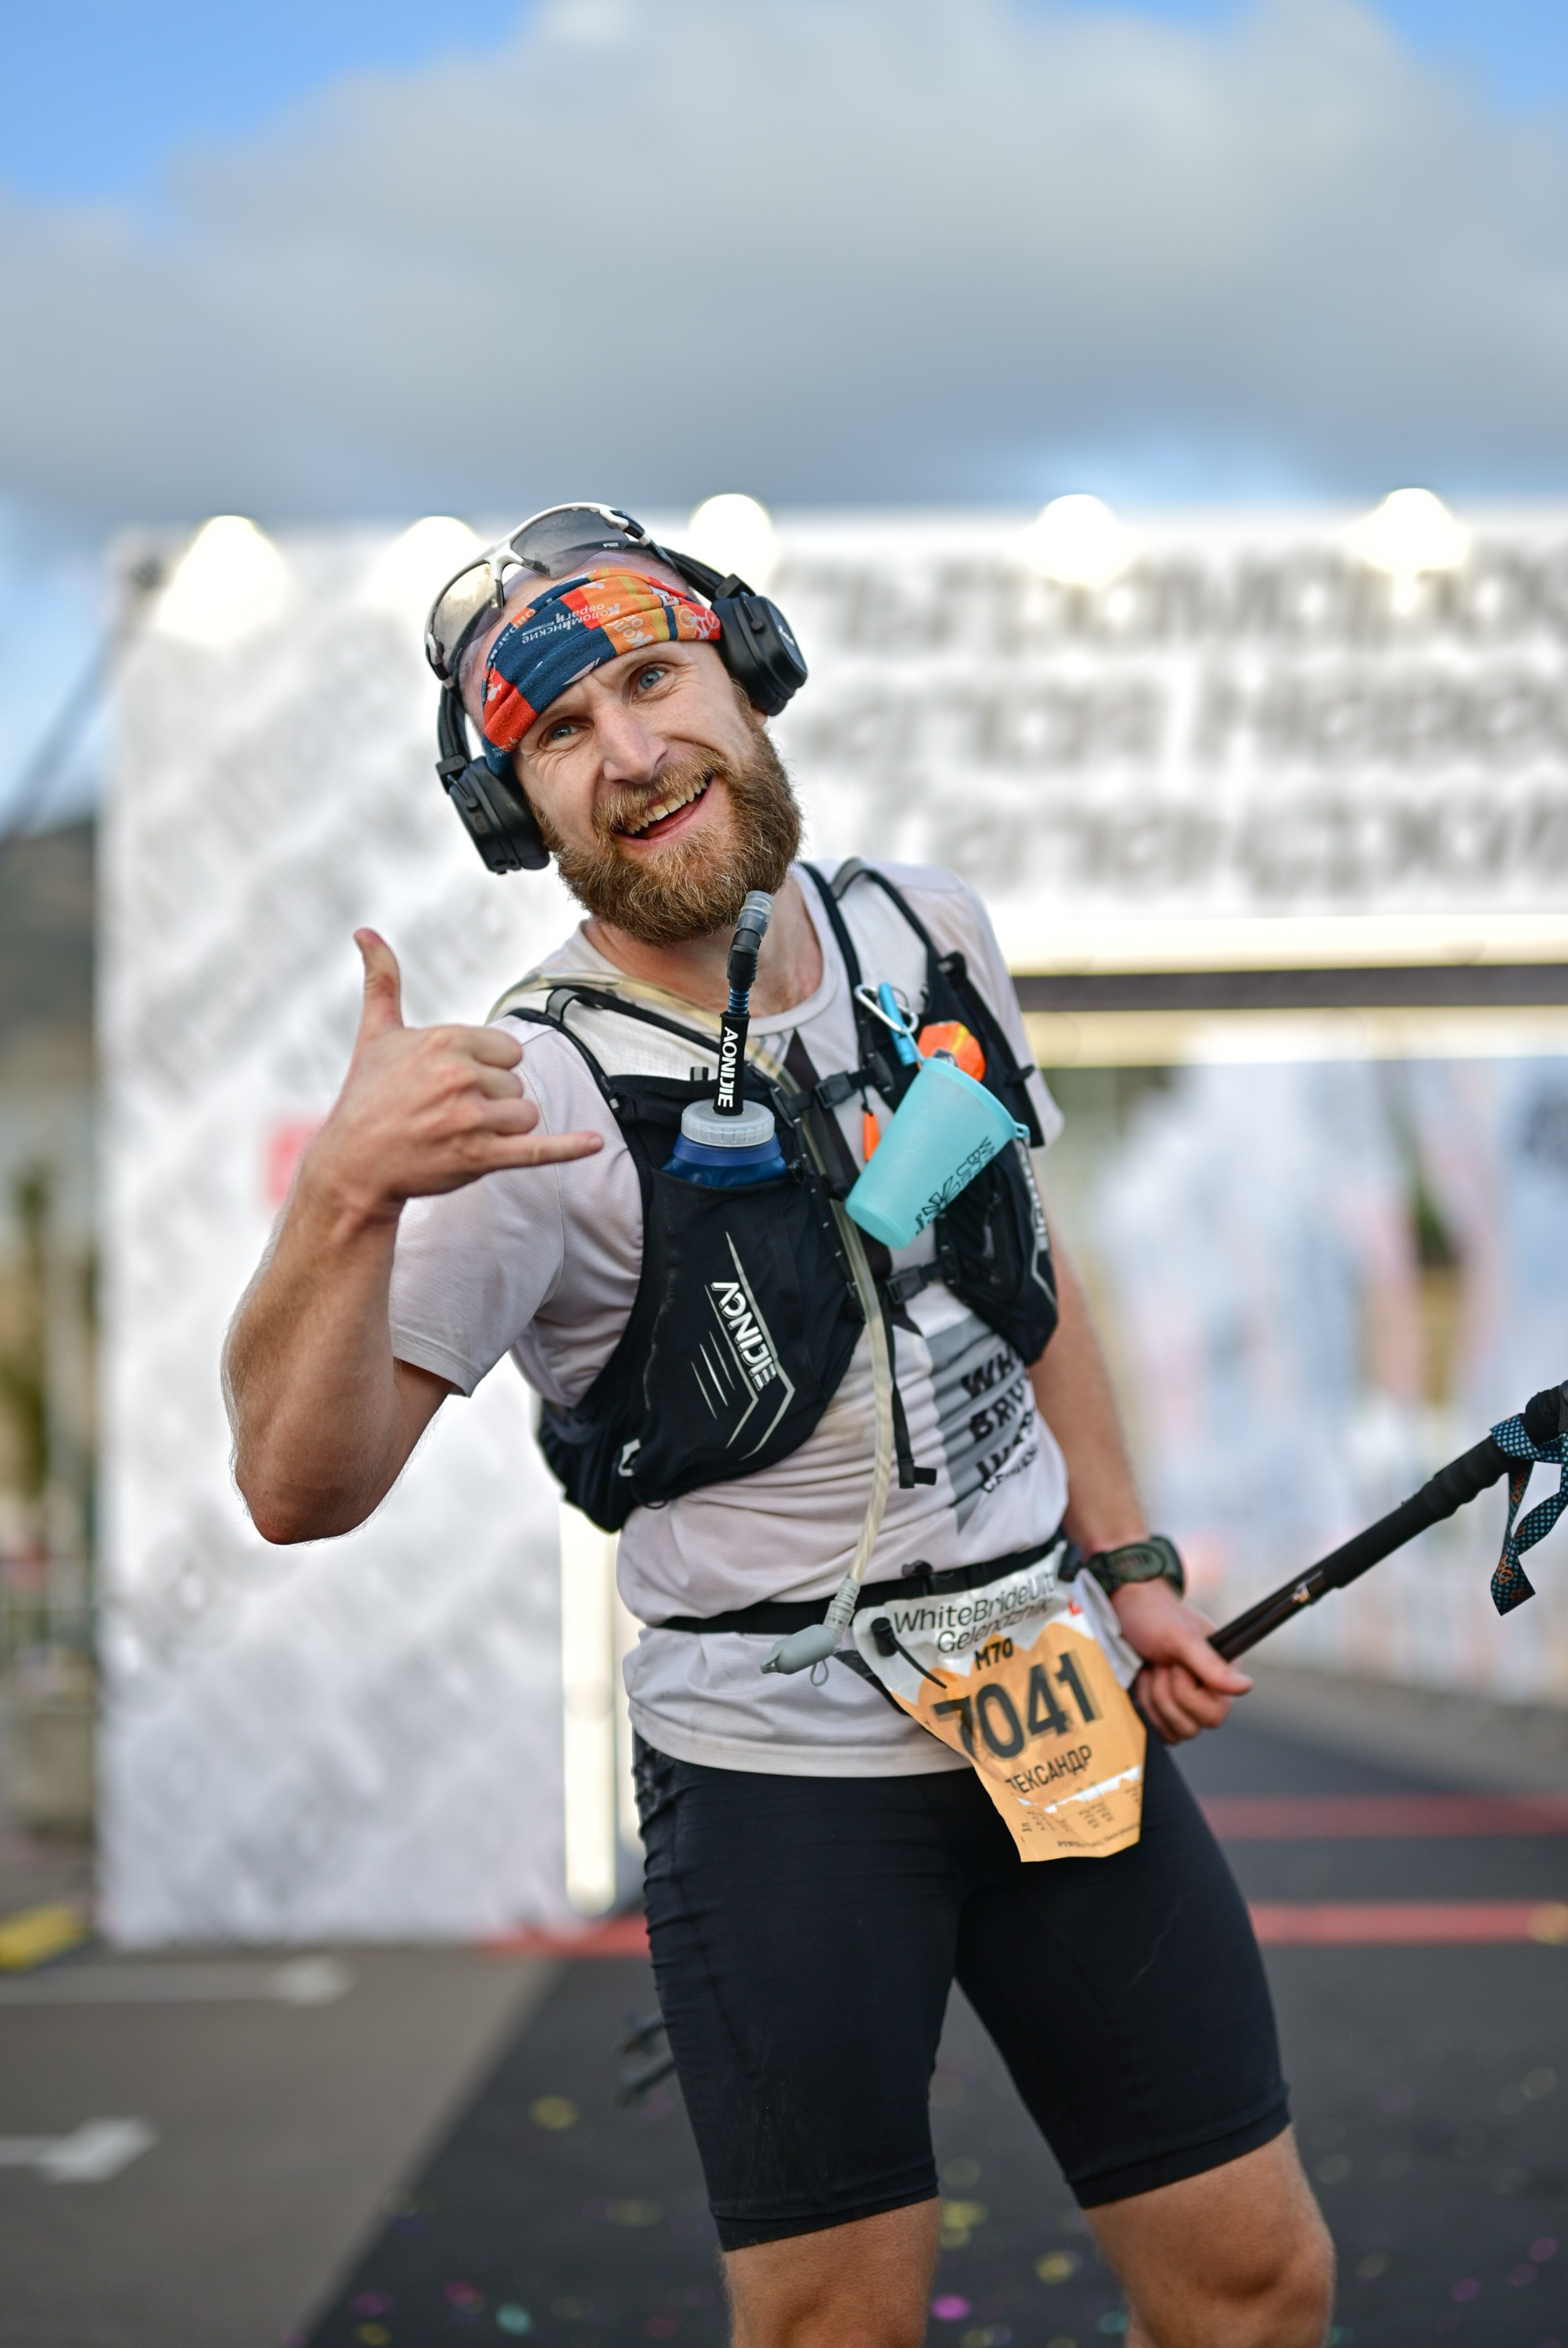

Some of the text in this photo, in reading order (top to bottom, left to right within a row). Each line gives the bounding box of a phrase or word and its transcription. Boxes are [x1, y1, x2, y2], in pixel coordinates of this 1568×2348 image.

[717, 1026, 739, 1108] AONIJIE
[710, 1281, 777, 1392] AONIJIE
[894, 1572, 1055, 1633] WhiteBrideUlt
[932, 1650, 1097, 1762] 7041
